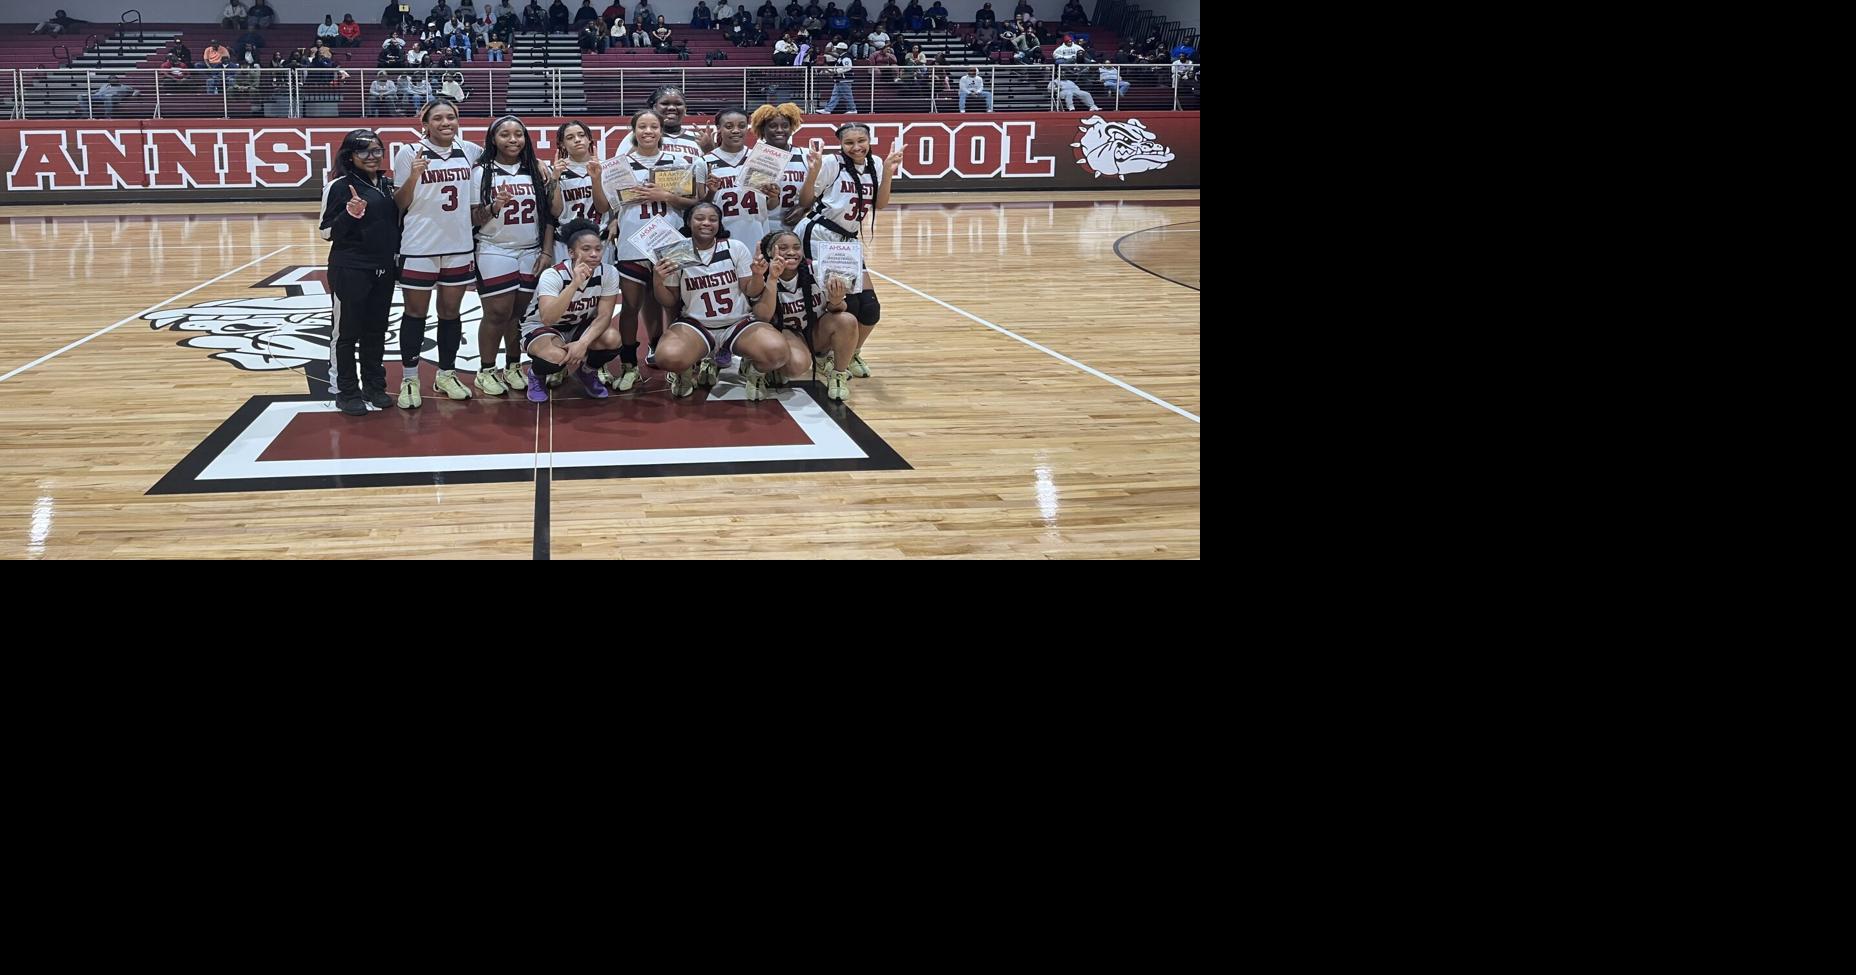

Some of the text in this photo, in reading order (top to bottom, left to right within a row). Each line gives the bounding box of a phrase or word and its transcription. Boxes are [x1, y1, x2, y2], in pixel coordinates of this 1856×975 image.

[441, 185, 459, 211] 3
[640, 200, 667, 219] 10
[721, 190, 759, 217] 24
[504, 199, 536, 225] 22
[700, 287, 734, 318] 15
